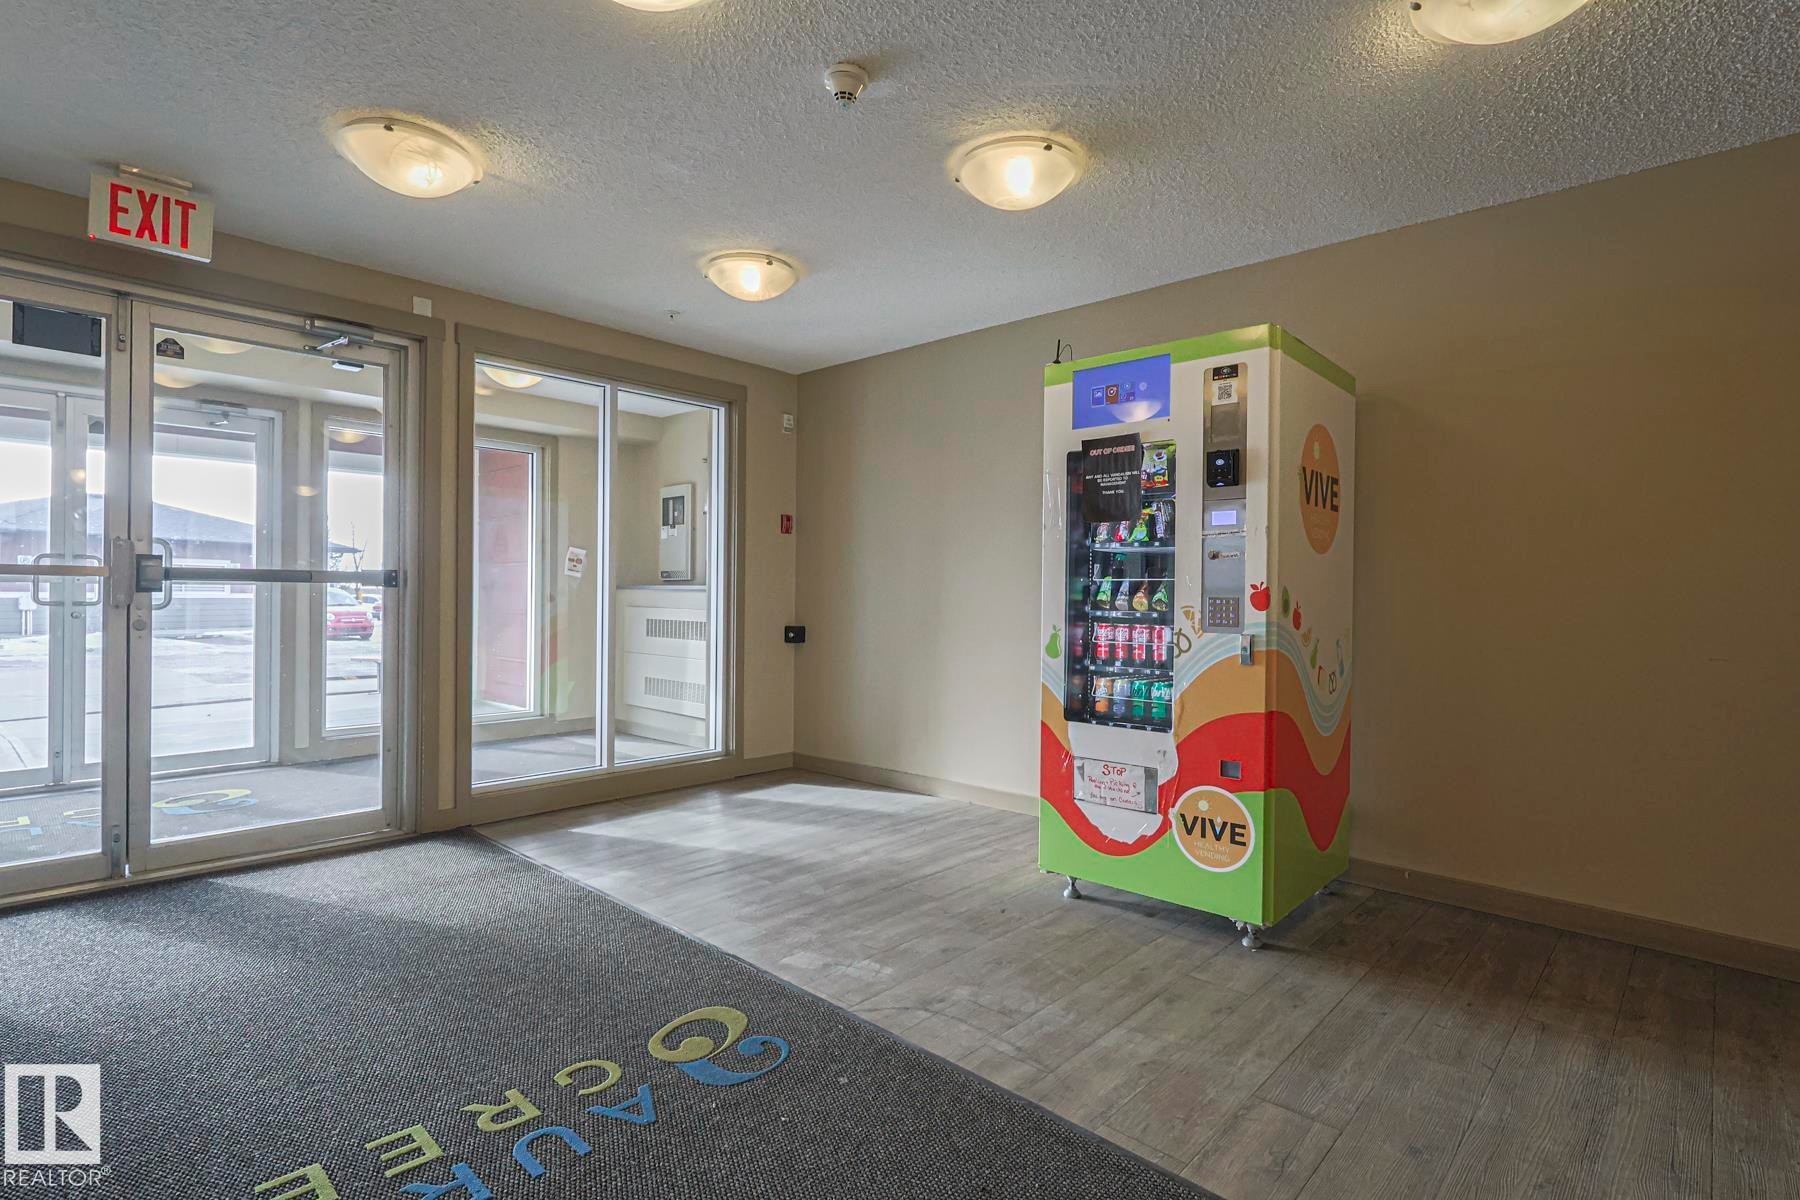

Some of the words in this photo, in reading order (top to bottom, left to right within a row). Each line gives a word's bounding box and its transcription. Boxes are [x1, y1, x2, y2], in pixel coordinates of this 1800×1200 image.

[108, 182, 197, 250] EXIT
[1302, 466, 1339, 513] VIVE
[1102, 763, 1127, 777] STOP
[1179, 813, 1247, 847] VIVE
